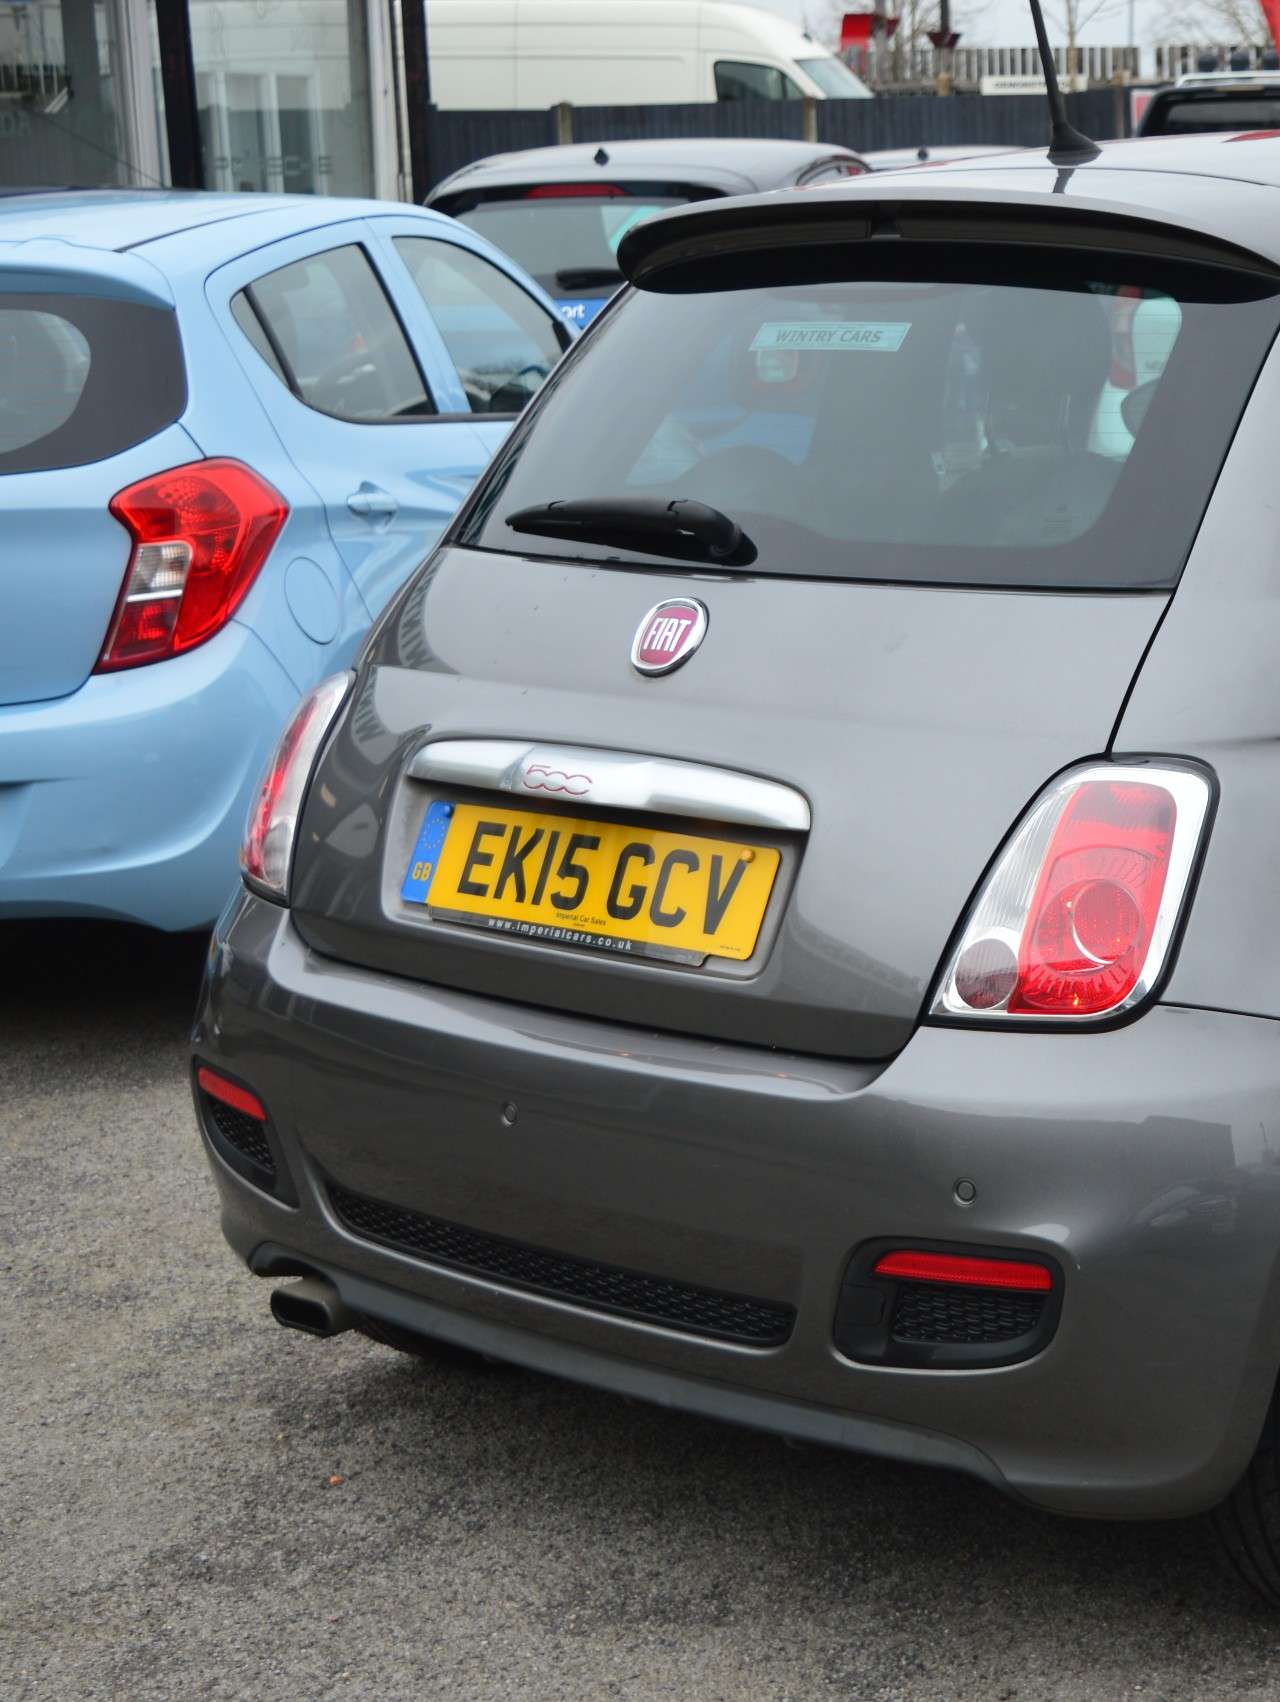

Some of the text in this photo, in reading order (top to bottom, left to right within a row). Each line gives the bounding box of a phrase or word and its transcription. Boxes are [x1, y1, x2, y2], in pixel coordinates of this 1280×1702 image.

[775, 329, 884, 343] WINTRY CARS
[643, 617, 692, 652] FIAT
[523, 764, 593, 795] 500
[410, 861, 432, 882] GB
[456, 820, 752, 935] EK15 GCV
[487, 918, 633, 950] www.imperialcars.co.uk
